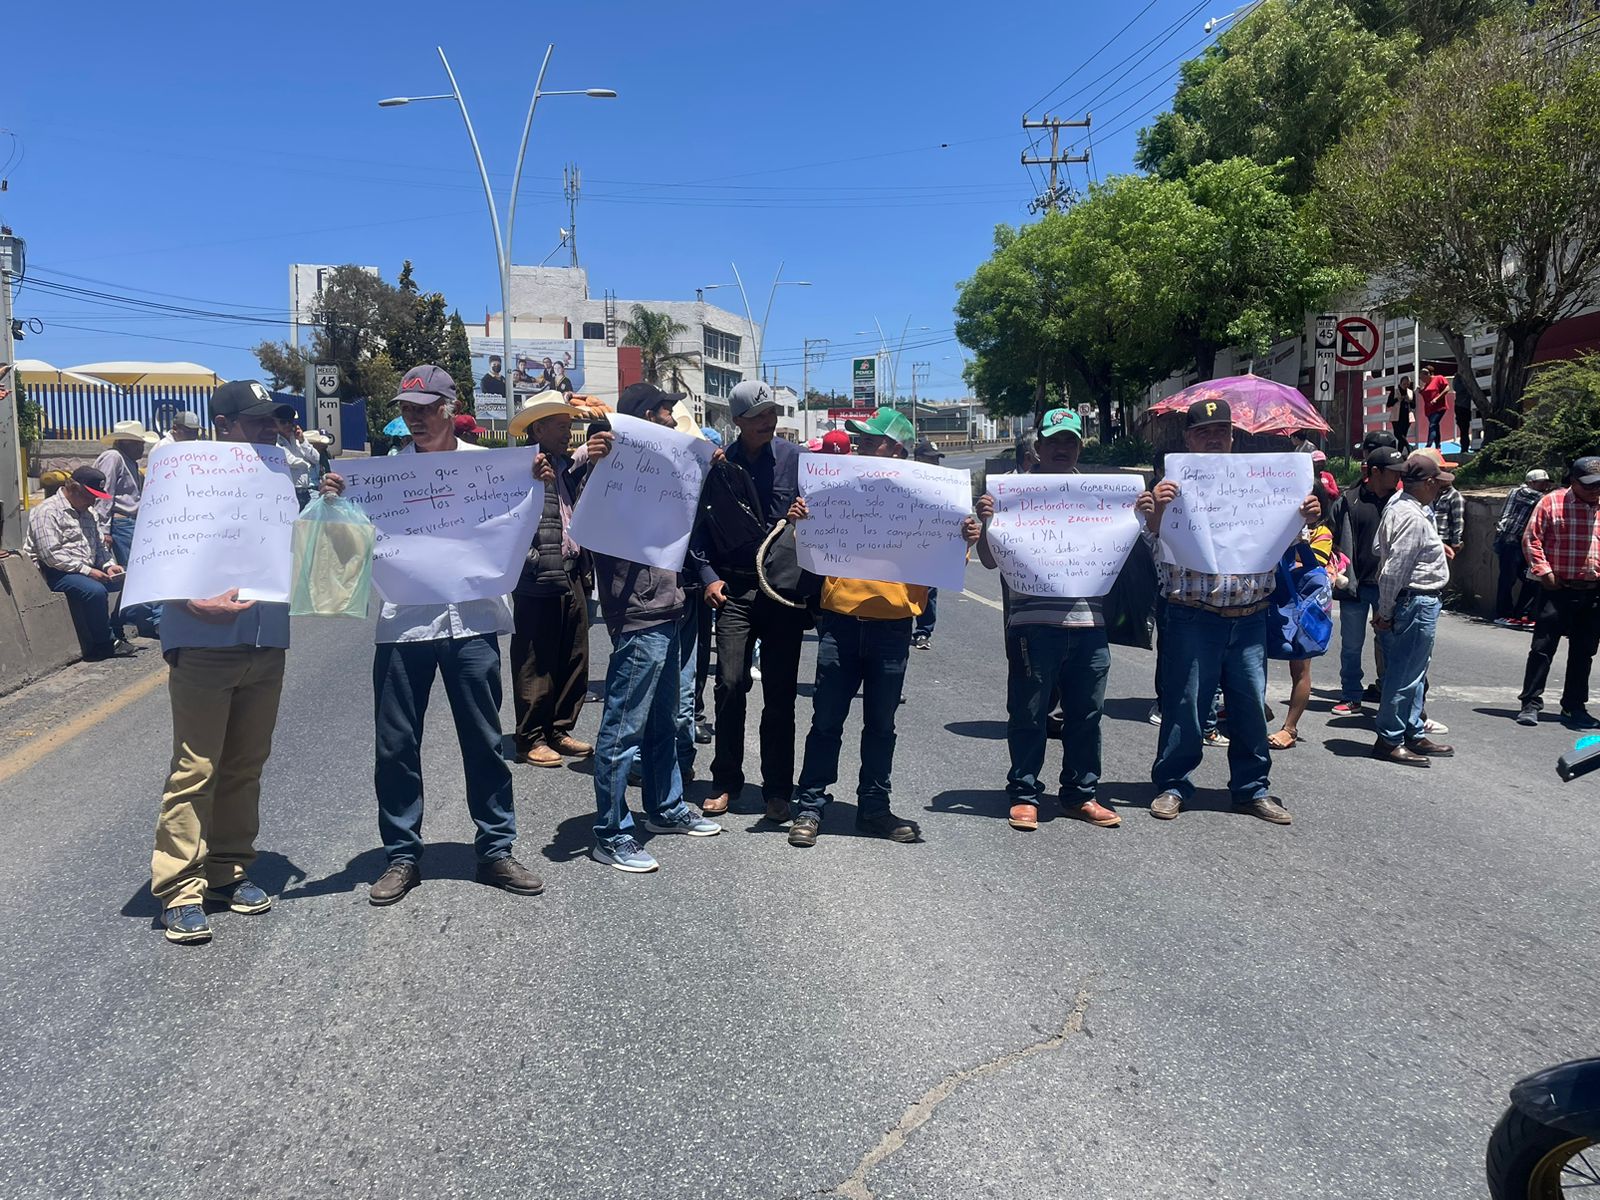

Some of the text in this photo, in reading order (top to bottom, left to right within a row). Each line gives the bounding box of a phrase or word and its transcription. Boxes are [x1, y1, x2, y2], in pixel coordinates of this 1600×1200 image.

[1318, 329, 1334, 340] 45
[1316, 350, 1334, 359] km
[1322, 363, 1329, 375] 1
[319, 375, 336, 388] 45
[319, 399, 338, 409] km
[1205, 403, 1217, 417] P
[326, 413, 333, 427] 1
[611, 451, 624, 470] los
[671, 446, 688, 463] que
[152, 453, 218, 477] programa
[1226, 465, 1235, 479] la
[347, 464, 494, 489] Exigimos que no
[186, 483, 248, 498] hechando
[403, 482, 453, 498] moches
[487, 471, 505, 485] los
[634, 476, 647, 493] los
[861, 484, 876, 493] no
[884, 484, 922, 499] vengas
[1058, 480, 1069, 492] al
[1080, 480, 1137, 493] GOBERNADOR
[1196, 485, 1204, 497] la
[1217, 482, 1261, 498] delegada
[430, 495, 450, 509] los
[998, 499, 1008, 513] la
[1096, 498, 1111, 510] de
[824, 507, 832, 519] la
[1231, 504, 1238, 516] y
[146, 507, 216, 529] servidores
[231, 507, 248, 521] de
[403, 517, 465, 536] servidores
[478, 507, 493, 523] de
[1188, 519, 1202, 531] los
[1209, 518, 1264, 531] campesinos
[863, 524, 877, 535] los
[1090, 541, 1103, 553] de
